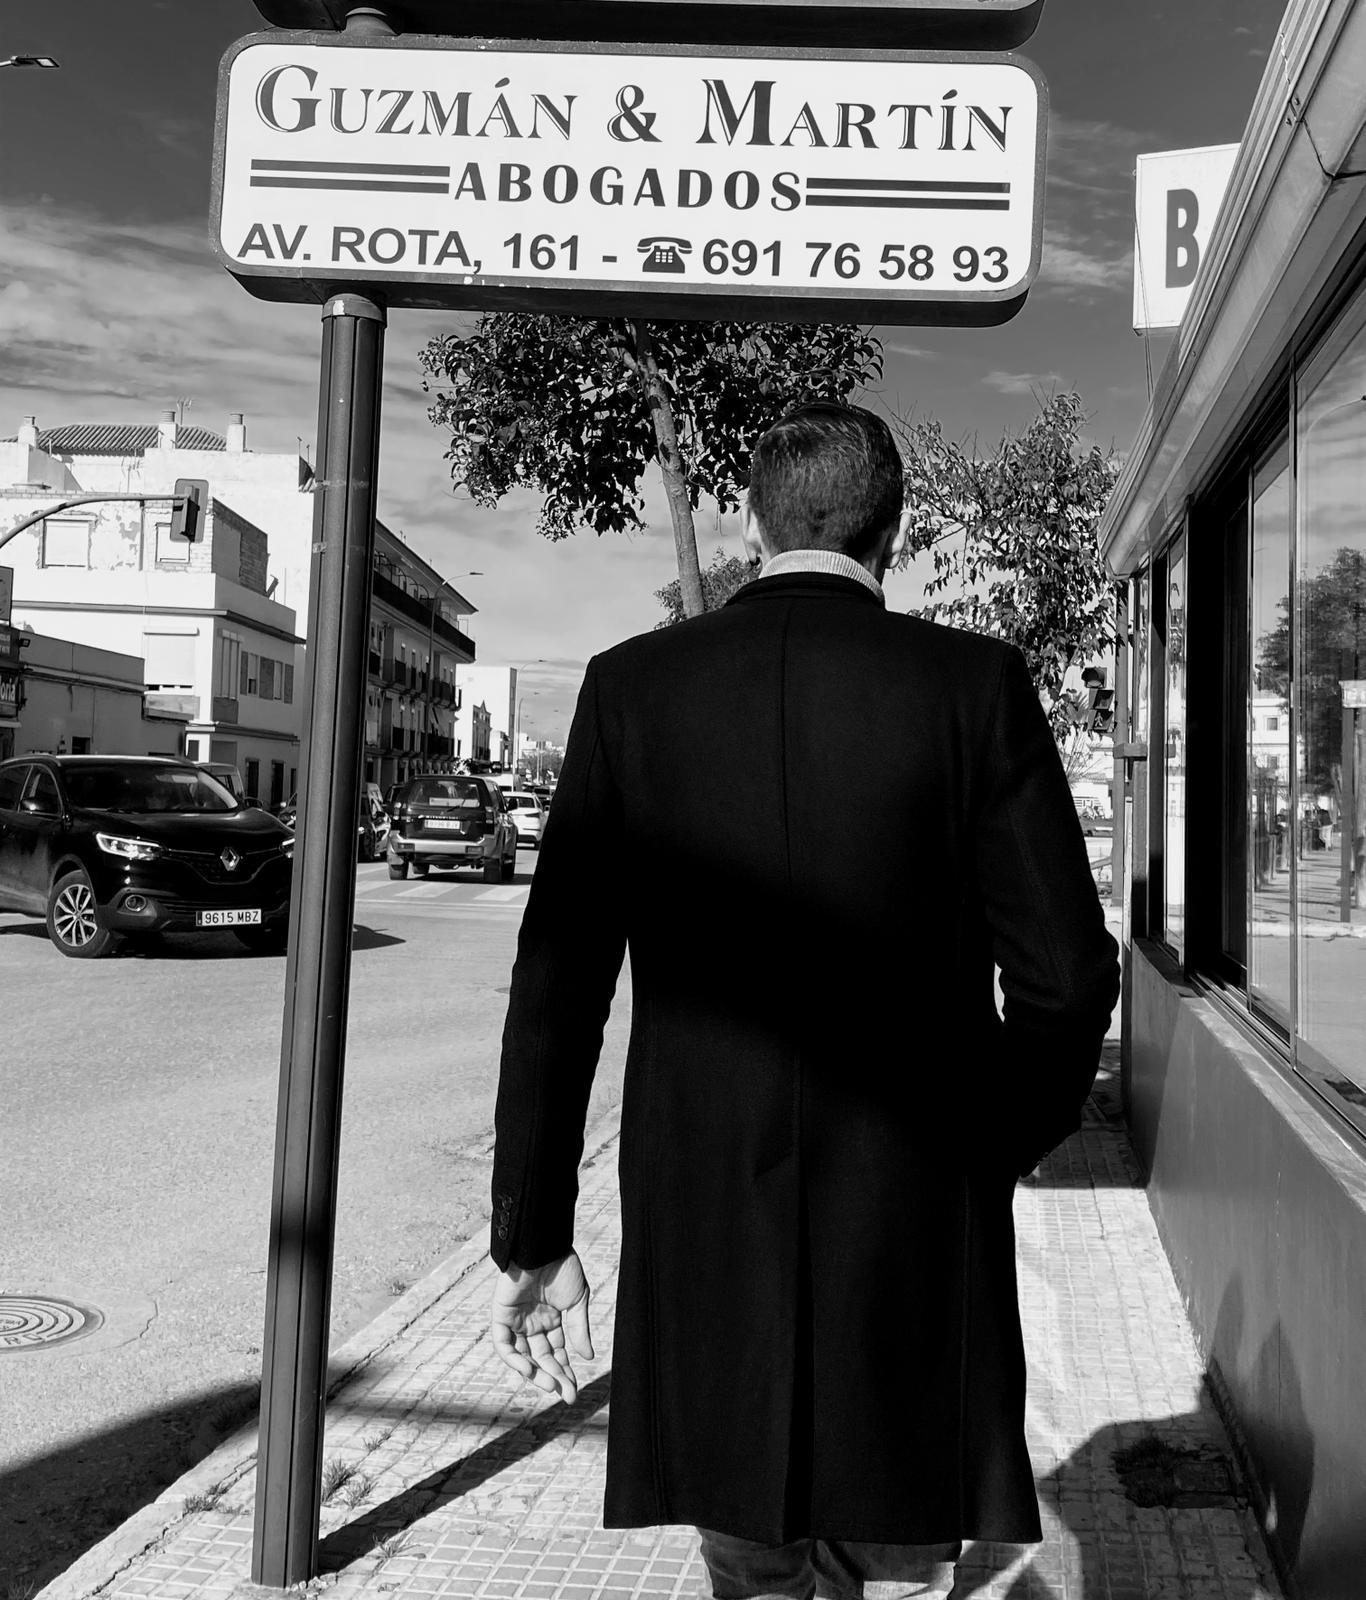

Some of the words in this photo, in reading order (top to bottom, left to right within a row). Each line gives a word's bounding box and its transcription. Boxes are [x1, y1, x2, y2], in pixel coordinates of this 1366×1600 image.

[256, 65, 578, 141] GUZMÁN
[607, 85, 662, 145] &
[696, 79, 1013, 153] MARTÍN
[455, 163, 801, 211] ABOGADOS
[236, 223, 311, 262] AV.
[332, 227, 482, 275] ROTA,
[504, 233, 579, 272] 161
[703, 239, 781, 277] 691
[806, 242, 861, 280] 76
[879, 245, 934, 282] 58
[953, 246, 1009, 284] 93
[205, 911, 234, 924] 9615
[237, 911, 260, 923] MBZ
